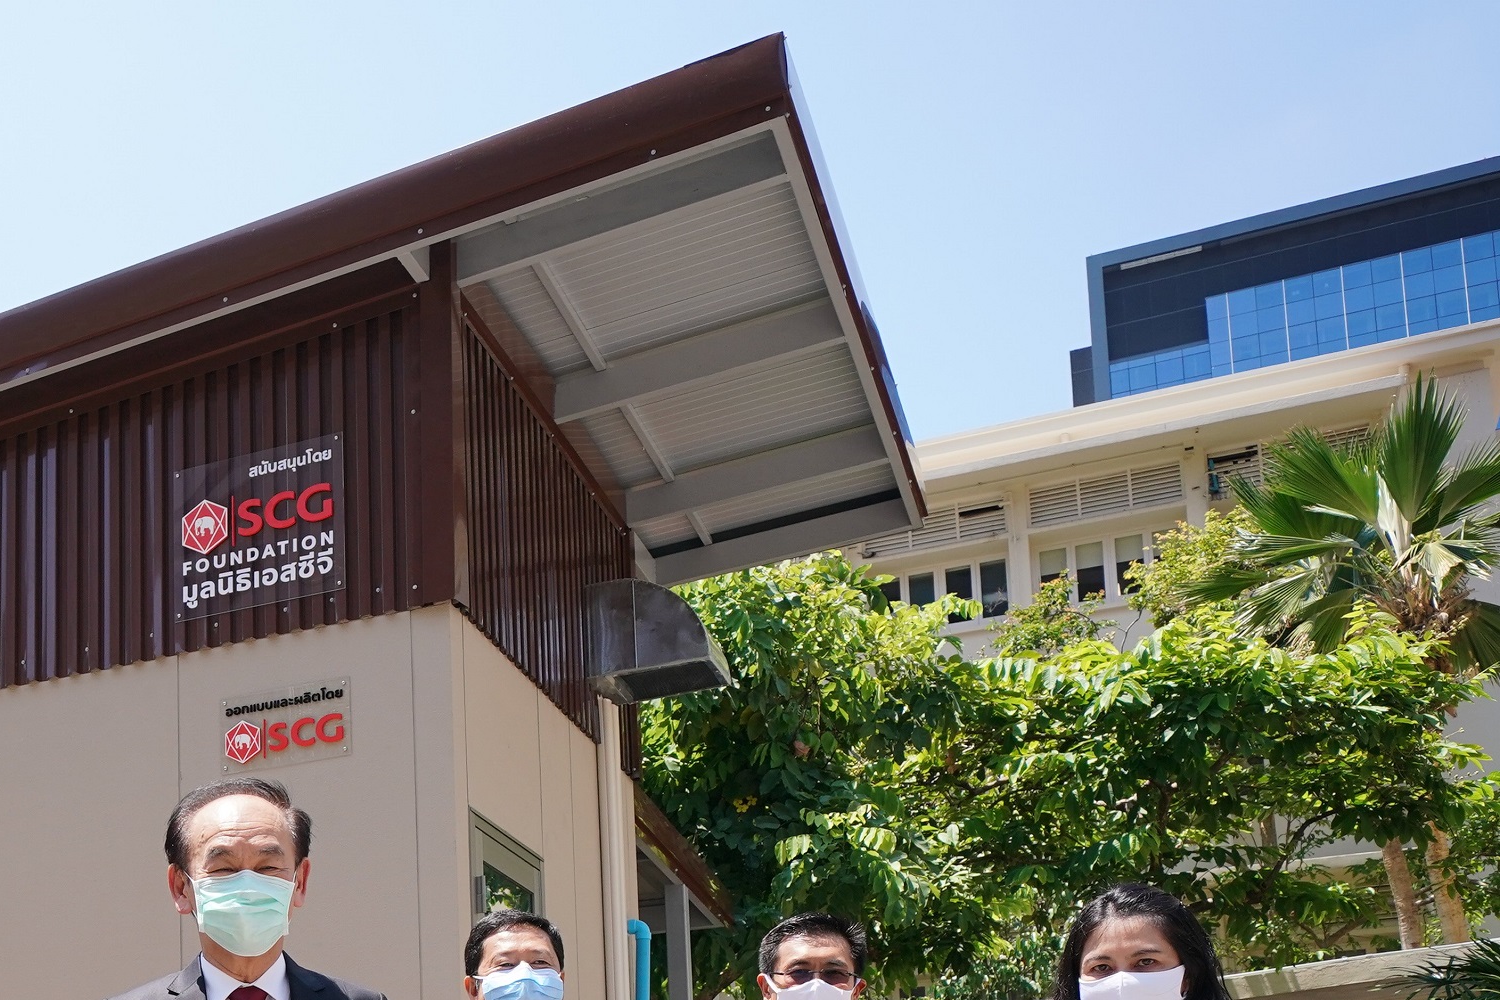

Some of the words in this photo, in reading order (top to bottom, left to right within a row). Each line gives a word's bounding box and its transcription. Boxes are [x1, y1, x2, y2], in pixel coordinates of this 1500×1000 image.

[248, 447, 332, 478] สนับสนุนโดย
[237, 482, 335, 538] SCG
[182, 530, 335, 577] FOUNDATION
[182, 547, 335, 609] มูลนิธิเอสซีจี
[225, 687, 344, 717] ออกแบบและผลิตโดย
[268, 712, 345, 752] SCG
